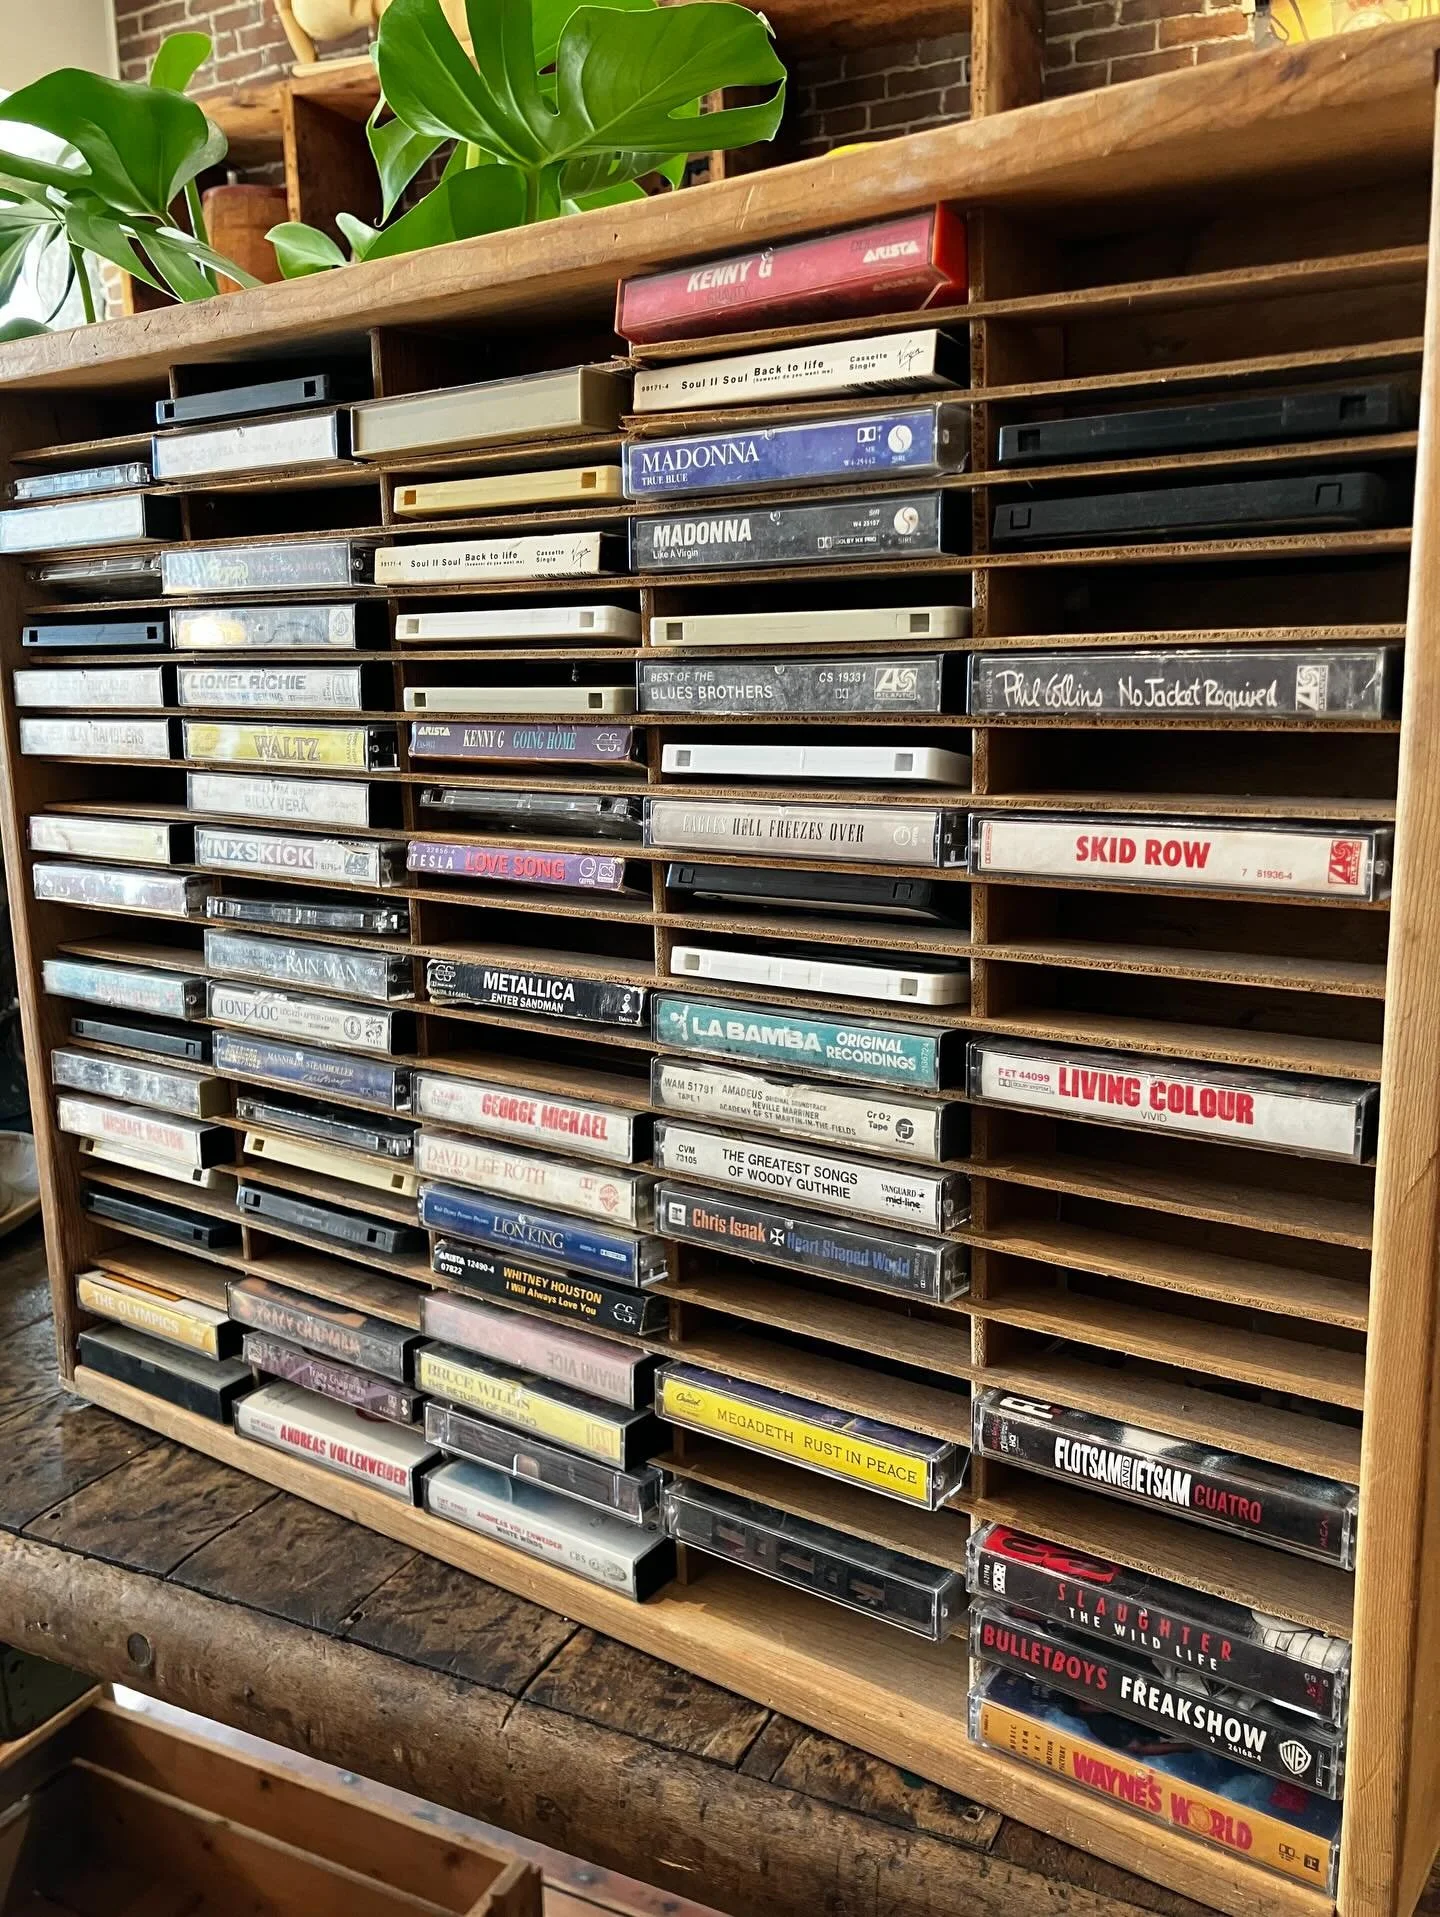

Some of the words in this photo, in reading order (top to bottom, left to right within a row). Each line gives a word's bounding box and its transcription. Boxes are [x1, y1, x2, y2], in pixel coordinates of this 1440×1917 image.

[863, 240, 920, 263] ARISTA
[687, 261, 752, 293] KENNY
[759, 255, 773, 279] G
[754, 363, 782, 377] Back
[787, 363, 799, 373] to
[804, 359, 825, 371] life
[849, 353, 888, 363] Cassette
[849, 361, 876, 371] Single
[681, 378, 705, 390] Soul
[723, 373, 748, 385] Soul
[641, 441, 760, 475] MADONNA
[642, 475, 665, 487] TRUE
[666, 472, 688, 485] BLUE
[653, 518, 752, 548] MADONNA
[411, 560, 429, 568] Soul
[442, 558, 461, 567] Soul
[465, 553, 486, 562] Back
[490, 552, 498, 560] to
[502, 551, 518, 560] life
[653, 548, 668, 560] Like
[669, 548, 676, 558] A
[676, 547, 699, 561] Virgin
[190, 674, 248, 689] LIONEL
[249, 674, 307, 690] RICHIE
[651, 671, 674, 683] BEST
[677, 671, 691, 682] OF
[694, 671, 713, 682] THE
[819, 672, 833, 683] CS
[838, 672, 866, 683] 19331
[995, 669, 1041, 708] Phil
[1045, 672, 1103, 708] Collins
[1118, 677, 1143, 708] No
[1144, 675, 1200, 708] Jacket
[1205, 677, 1278, 708] Required
[651, 686, 693, 700] BLUES
[698, 685, 773, 700] BROTHERS
[418, 726, 450, 736] ARISTA
[463, 730, 496, 747] KENNY
[497, 730, 505, 748] G
[513, 731, 544, 749] GOING
[548, 732, 577, 750] HOME
[254, 735, 321, 761] WALTZ
[732, 817, 762, 837] HELL
[769, 819, 823, 840] FREEZES
[830, 822, 864, 843] OVER
[207, 838, 258, 862] INXS
[260, 843, 315, 869] KICK
[1076, 836, 1137, 863] SKID
[1144, 839, 1211, 869] ROW
[411, 853, 454, 870] TESLA
[465, 851, 509, 875] LOVE
[513, 857, 566, 881] SONG
[1241, 869, 1247, 877] 7
[1256, 869, 1293, 880] 81936-4
[286, 954, 320, 976] RAIN
[323, 961, 358, 983] MAN
[483, 971, 575, 1002] METALLICA
[219, 998, 250, 1017] TONE
[492, 994, 518, 1007] ENTER
[520, 998, 564, 1013] SANDMAN
[692, 1016, 720, 1036] LA
[726, 1022, 822, 1052] BAMBA
[836, 1031, 903, 1055] ORIGINAL
[305, 1061, 354, 1078] STEAMROLLER
[826, 1045, 917, 1071] RECORDINGS
[664, 1077, 685, 1089] WAM
[999, 1067, 1017, 1078] FET
[1019, 1071, 1050, 1083] 44099
[721, 1084, 764, 1099] AMADEUS
[1059, 1066, 1141, 1107] LIVING
[1150, 1081, 1254, 1125] COLOUR
[481, 1093, 538, 1126] GEORGE
[540, 1103, 609, 1141] MICHAEL
[752, 1100, 780, 1113] NEVILLE
[782, 1106, 819, 1120] MARRINER
[1140, 1111, 1168, 1123] VIVID
[868, 1120, 889, 1132] Tape
[676, 1152, 697, 1165] 73105
[678, 1144, 695, 1155] CVM
[427, 1145, 471, 1169] DAVID
[475, 1155, 499, 1174] LEE
[504, 1161, 545, 1185] ROTH
[722, 1148, 745, 1163] THE
[747, 1152, 810, 1176] GREATEST
[813, 1165, 858, 1185] SONGS
[728, 1165, 743, 1177] OF
[746, 1168, 792, 1187] WOODY
[796, 1178, 851, 1199] GUTHRIE
[881, 1183, 917, 1199] VANGUARD
[886, 1195, 921, 1209] mid-line
[493, 1216, 525, 1238] LION
[528, 1225, 565, 1250] KING
[692, 1208, 727, 1232] Chris
[729, 1216, 766, 1243] Isaak
[786, 1229, 821, 1257] Heart
[822, 1237, 870, 1267] Shaped
[872, 1252, 911, 1277] World
[439, 1252, 466, 1266] ARISTA
[467, 1259, 495, 1274] 12490-4
[440, 1263, 463, 1276] 07822
[503, 1266, 549, 1288] WHITNEY
[551, 1280, 602, 1304] HOUSTON
[505, 1281, 510, 1290] I
[511, 1282, 526, 1295] Will
[527, 1287, 557, 1304] Always
[558, 1296, 578, 1309] Love
[580, 1301, 597, 1316] You
[93, 1289, 116, 1310] THE
[118, 1300, 180, 1335] OLYMPICS
[547, 1351, 578, 1379] VICE
[427, 1362, 474, 1388] BRUCE
[478, 1379, 531, 1411] WILLIS
[428, 1379, 448, 1393] THE
[449, 1384, 484, 1404] RETURN
[485, 1397, 499, 1409] OF
[501, 1406, 537, 1427] BRUNO
[279, 1424, 326, 1456] ANDREAS
[329, 1443, 408, 1487] VOLLENWEIDER
[717, 1408, 794, 1445] MEGADETH
[804, 1436, 842, 1459] RUST
[845, 1449, 862, 1466] IN
[866, 1456, 918, 1485] PEACE
[1054, 1436, 1122, 1488] FLOTSAM
[1121, 1456, 1131, 1488] AND
[1131, 1459, 1192, 1508] JETSAM
[1194, 1483, 1261, 1524] CUATRO
[1320, 1517, 1328, 1548] MCA
[570, 1551, 586, 1564] CBS
[1057, 1582, 1233, 1662] SLAUGHTER
[1069, 1607, 1101, 1630] THE
[1114, 1622, 1161, 1650] WILD
[1175, 1645, 1219, 1672] LIFE
[984, 1624, 1109, 1691] BULLETBOYS
[1120, 1676, 1267, 1753] FREAKSHOW
[1209, 1735, 1215, 1744] 9
[1228, 1742, 1263, 1762] 26168-4
[1072, 1751, 1163, 1814] WAYNE'S
